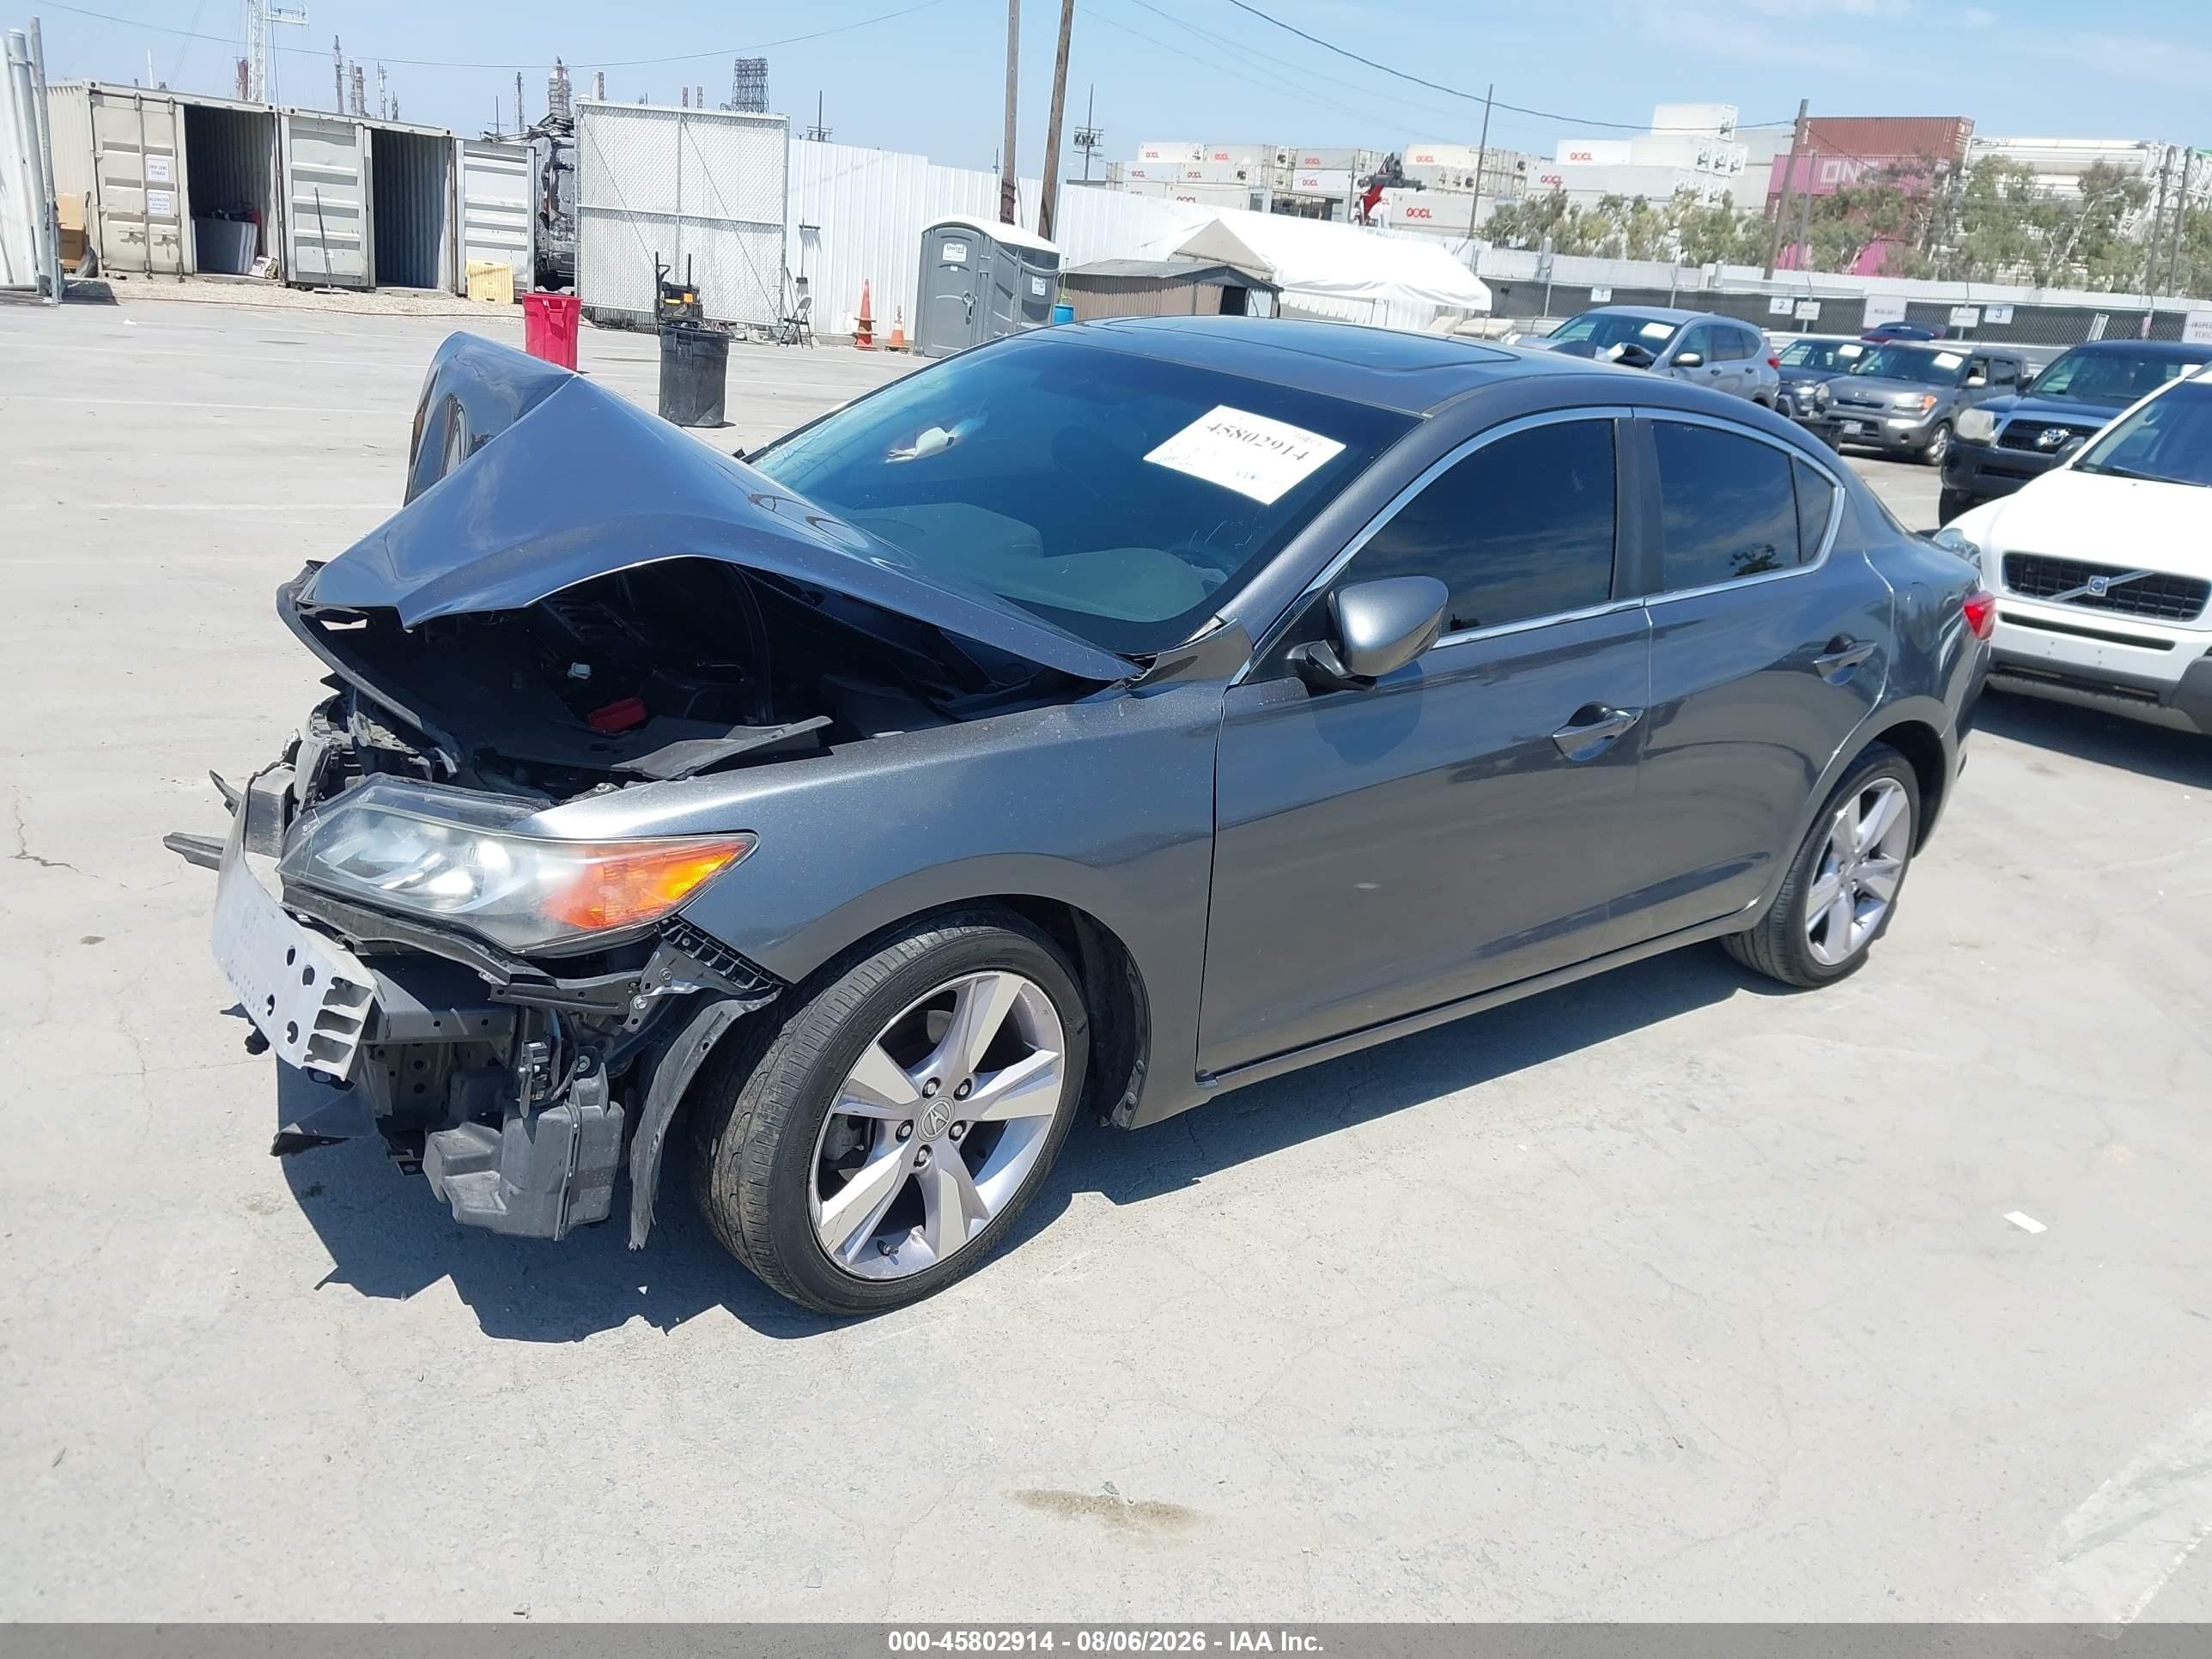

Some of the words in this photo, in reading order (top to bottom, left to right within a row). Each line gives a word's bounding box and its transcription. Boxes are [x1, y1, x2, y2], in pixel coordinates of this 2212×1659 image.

[1417, 155, 1435, 163] OOCL
[1570, 152, 1593, 161] OOCL
[1540, 174, 1564, 185] OOCL
[1406, 207, 1432, 219] OOCL
[1778, 301, 1785, 309] 2
[1996, 308, 2002, 318] 3
[1206, 422, 1310, 461] 45802914
